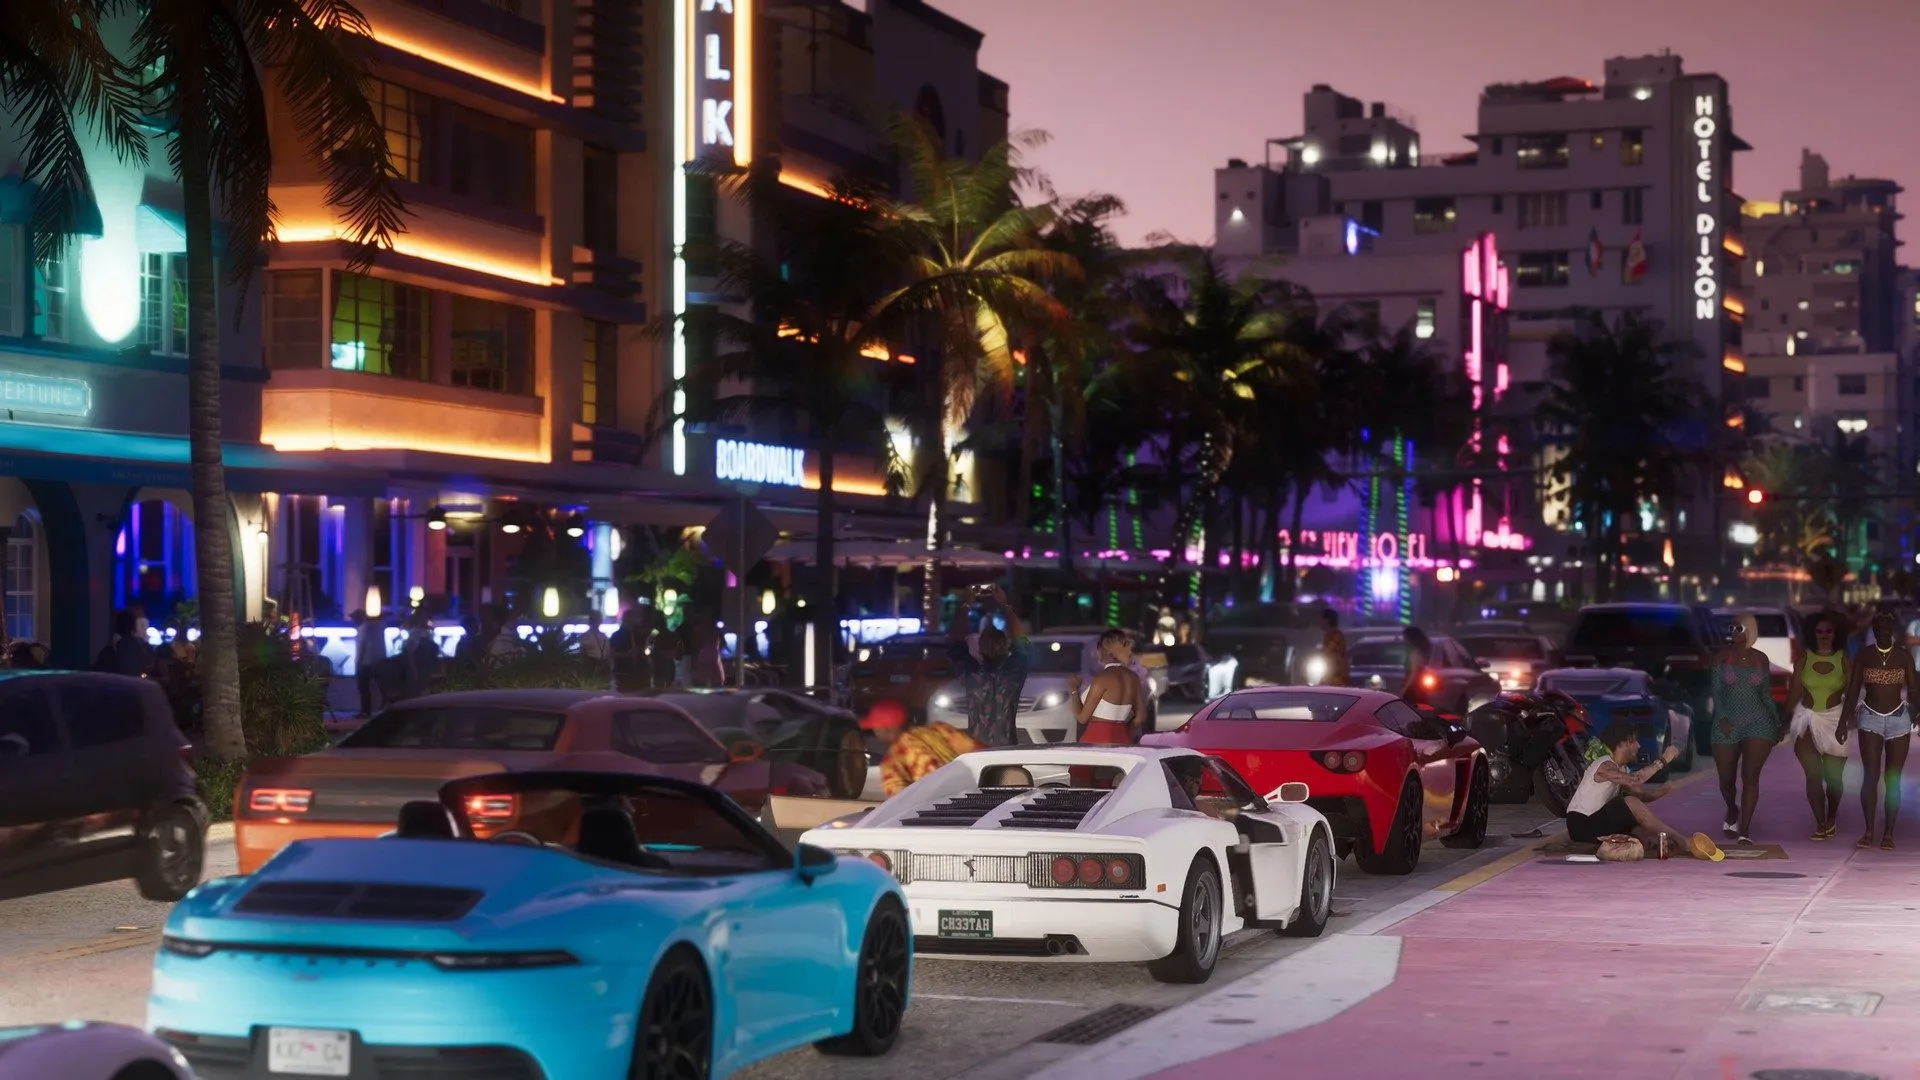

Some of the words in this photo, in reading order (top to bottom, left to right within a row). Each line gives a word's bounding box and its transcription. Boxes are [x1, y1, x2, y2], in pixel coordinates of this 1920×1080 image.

[700, 0, 734, 147] LK
[1693, 95, 1716, 203] HOTEL
[1693, 213, 1717, 320] DIXON
[716, 439, 805, 487] BOARDWALK
[941, 917, 990, 931] CH33TAH
